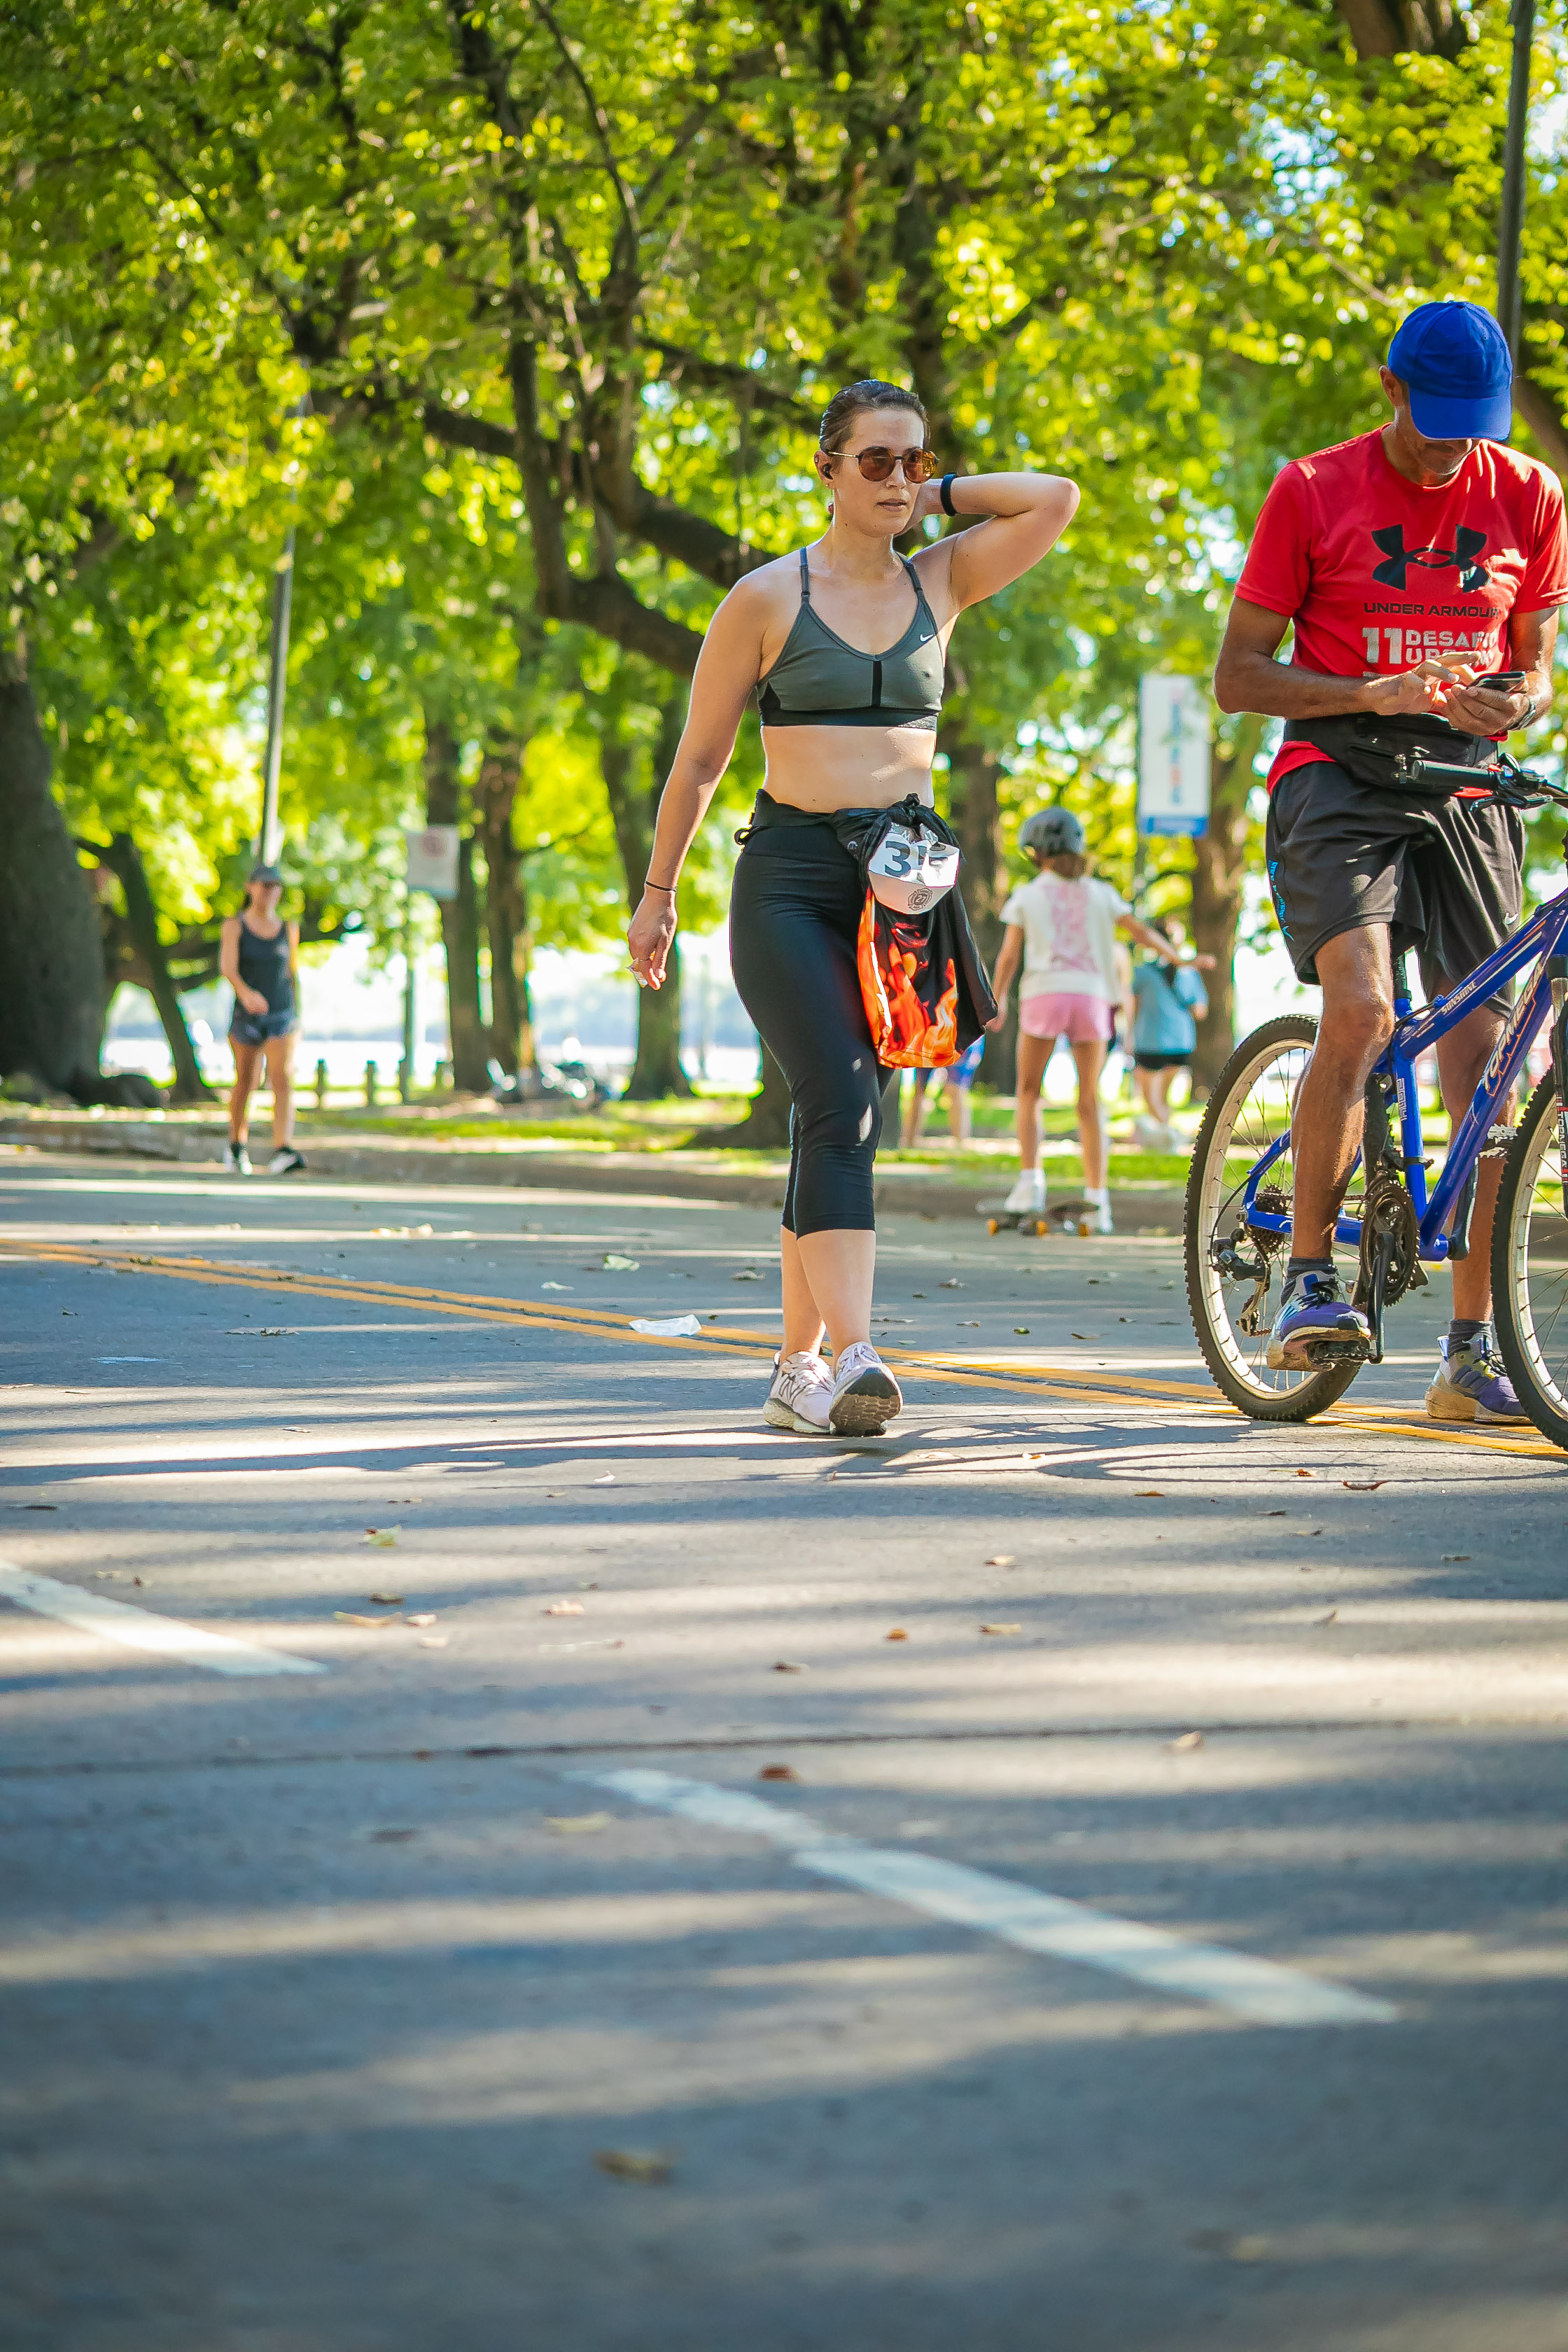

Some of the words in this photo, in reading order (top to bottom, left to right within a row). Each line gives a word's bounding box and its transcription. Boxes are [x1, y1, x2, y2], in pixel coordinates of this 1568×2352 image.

[1364, 602, 1424, 615] UNDER
[1428, 605, 1499, 618] ARMOUR
[1362, 627, 1402, 664] 11
